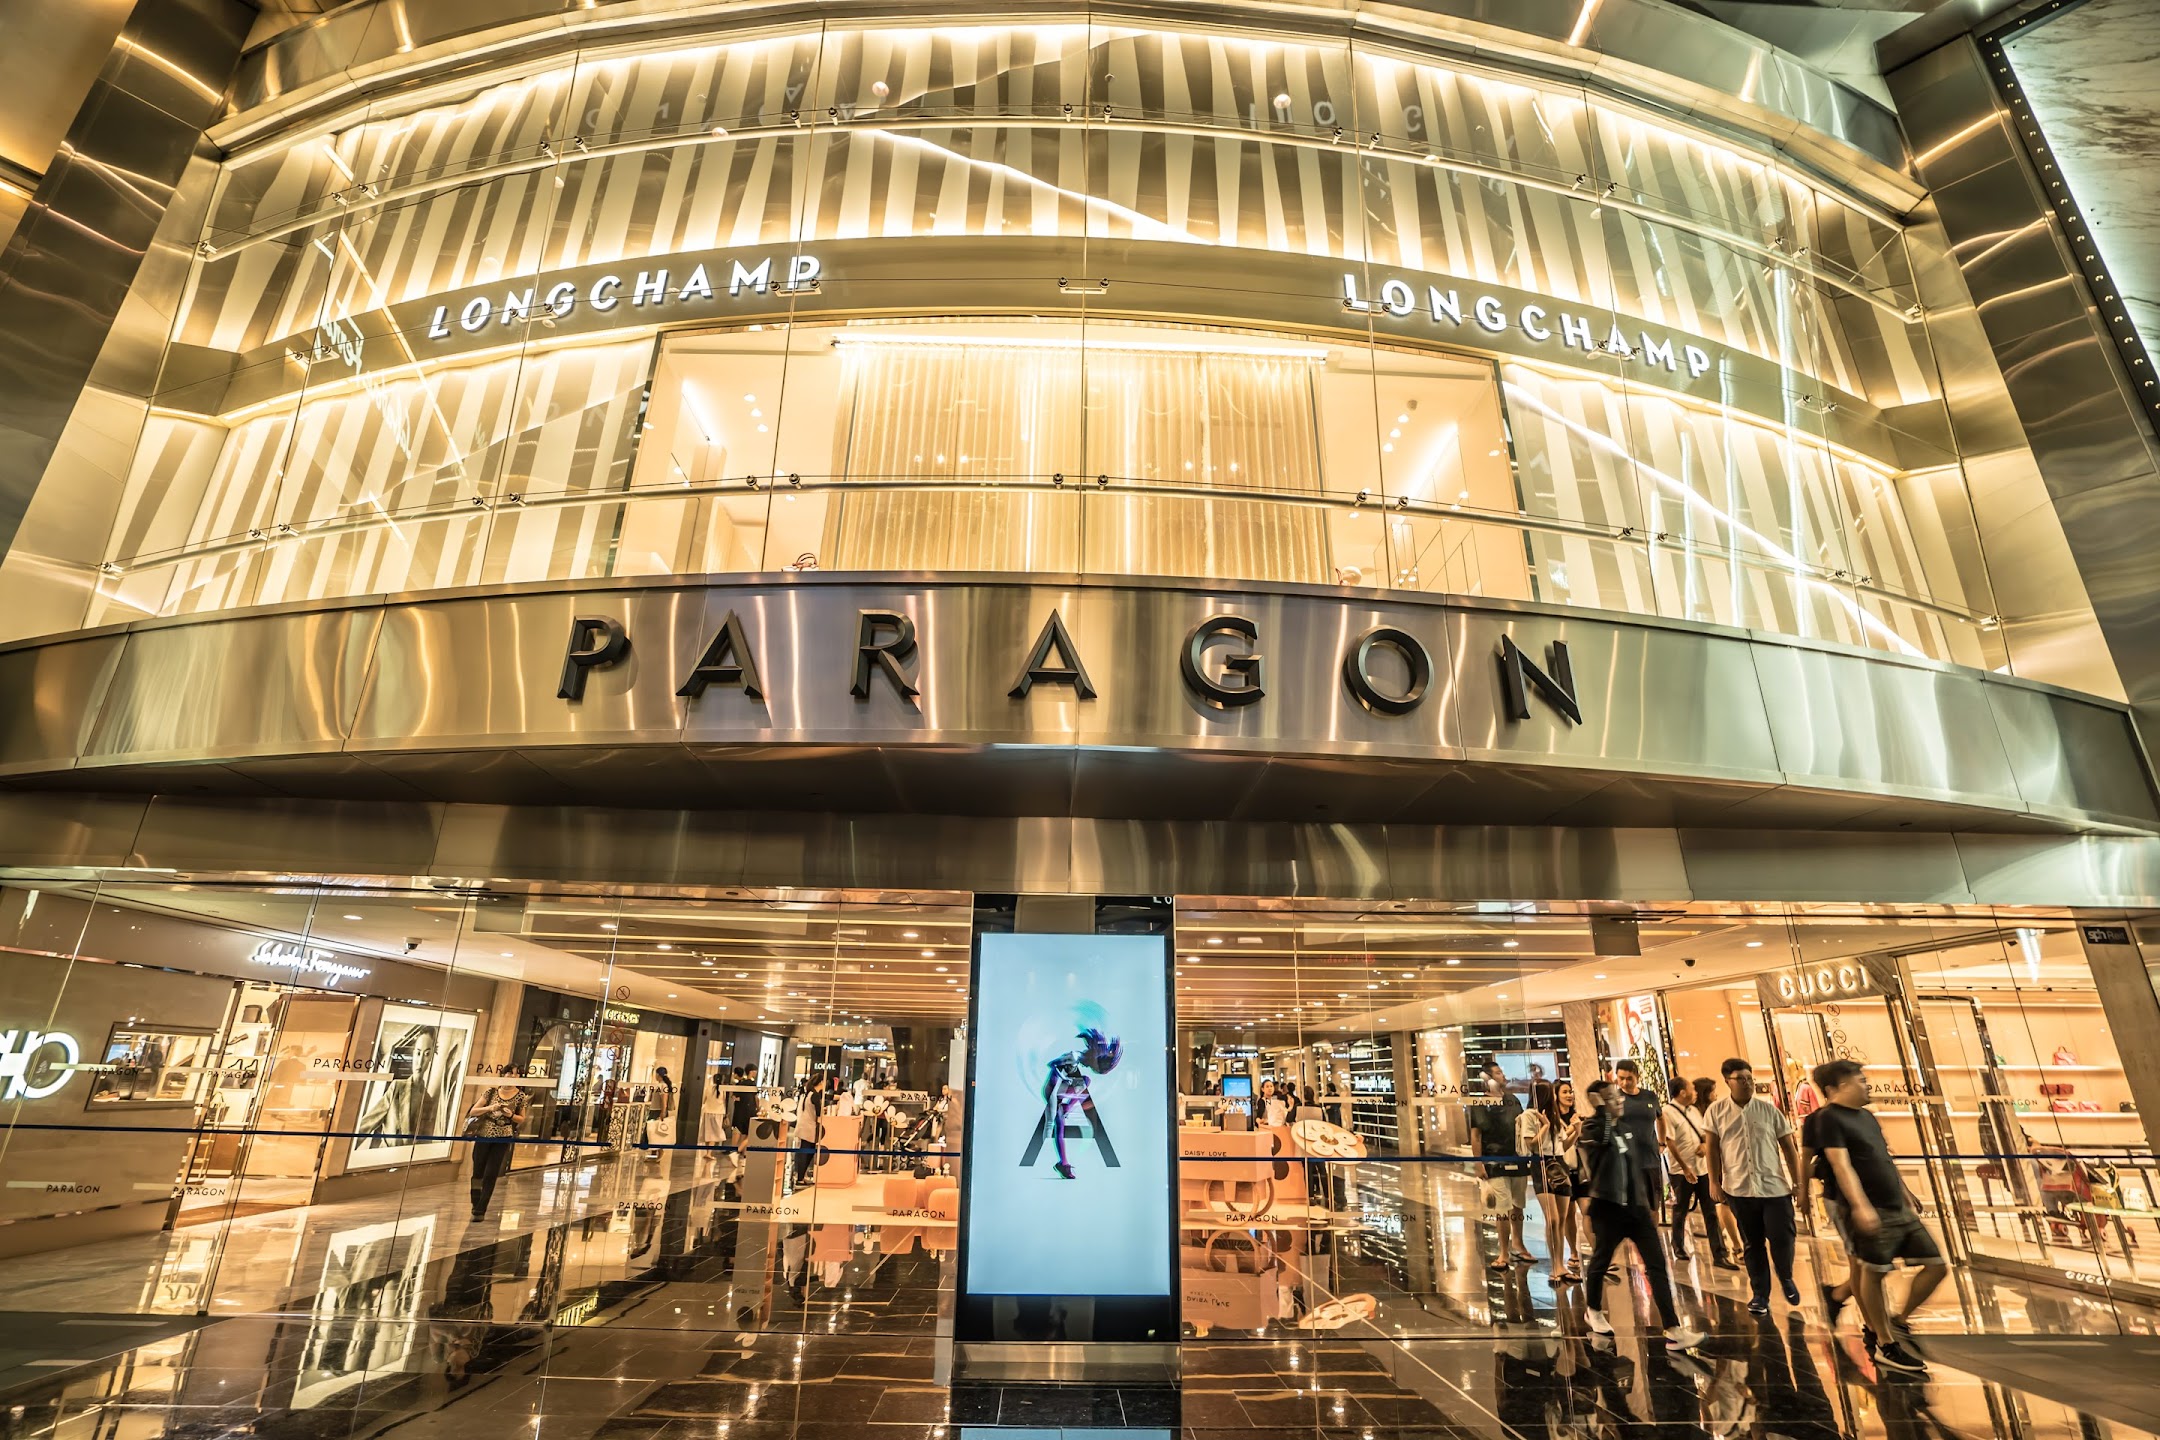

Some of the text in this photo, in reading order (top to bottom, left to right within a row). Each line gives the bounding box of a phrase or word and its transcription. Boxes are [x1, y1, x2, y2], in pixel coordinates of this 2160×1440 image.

[428, 255, 821, 339] LONGCHAMP
[1344, 273, 1711, 378] LONGCHAMP
[557, 608, 1582, 726] PARAGON
[1777, 965, 1870, 998] GUCCI
[313, 1058, 387, 1070] PARAGON
[813, 1062, 837, 1070] LOEWE
[88, 1067, 139, 1076] PARAGON
[635, 1085, 686, 1095] PARAGON
[758, 1089, 803, 1098] PARAGO
[1421, 1084, 1476, 1095] PARAG
[900, 1092, 953, 1102] PARAGON
[1221, 1098, 1272, 1106] PARAN
[1883, 1098, 1931, 1106] PARAGON
[1357, 1099, 1408, 1107] PARAON
[46, 1184, 101, 1193] PARAGON
[172, 1186, 226, 1196] PARAGON
[618, 1201, 671, 1211] PARAGON
[746, 1205, 799, 1215] PARAGON
[892, 1209, 946, 1219] PARAGON
[1226, 1214, 1278, 1222] PARAGON
[1482, 1213, 1533, 1222] PARAGON
[2065, 1270, 2113, 1287] GUCCI
